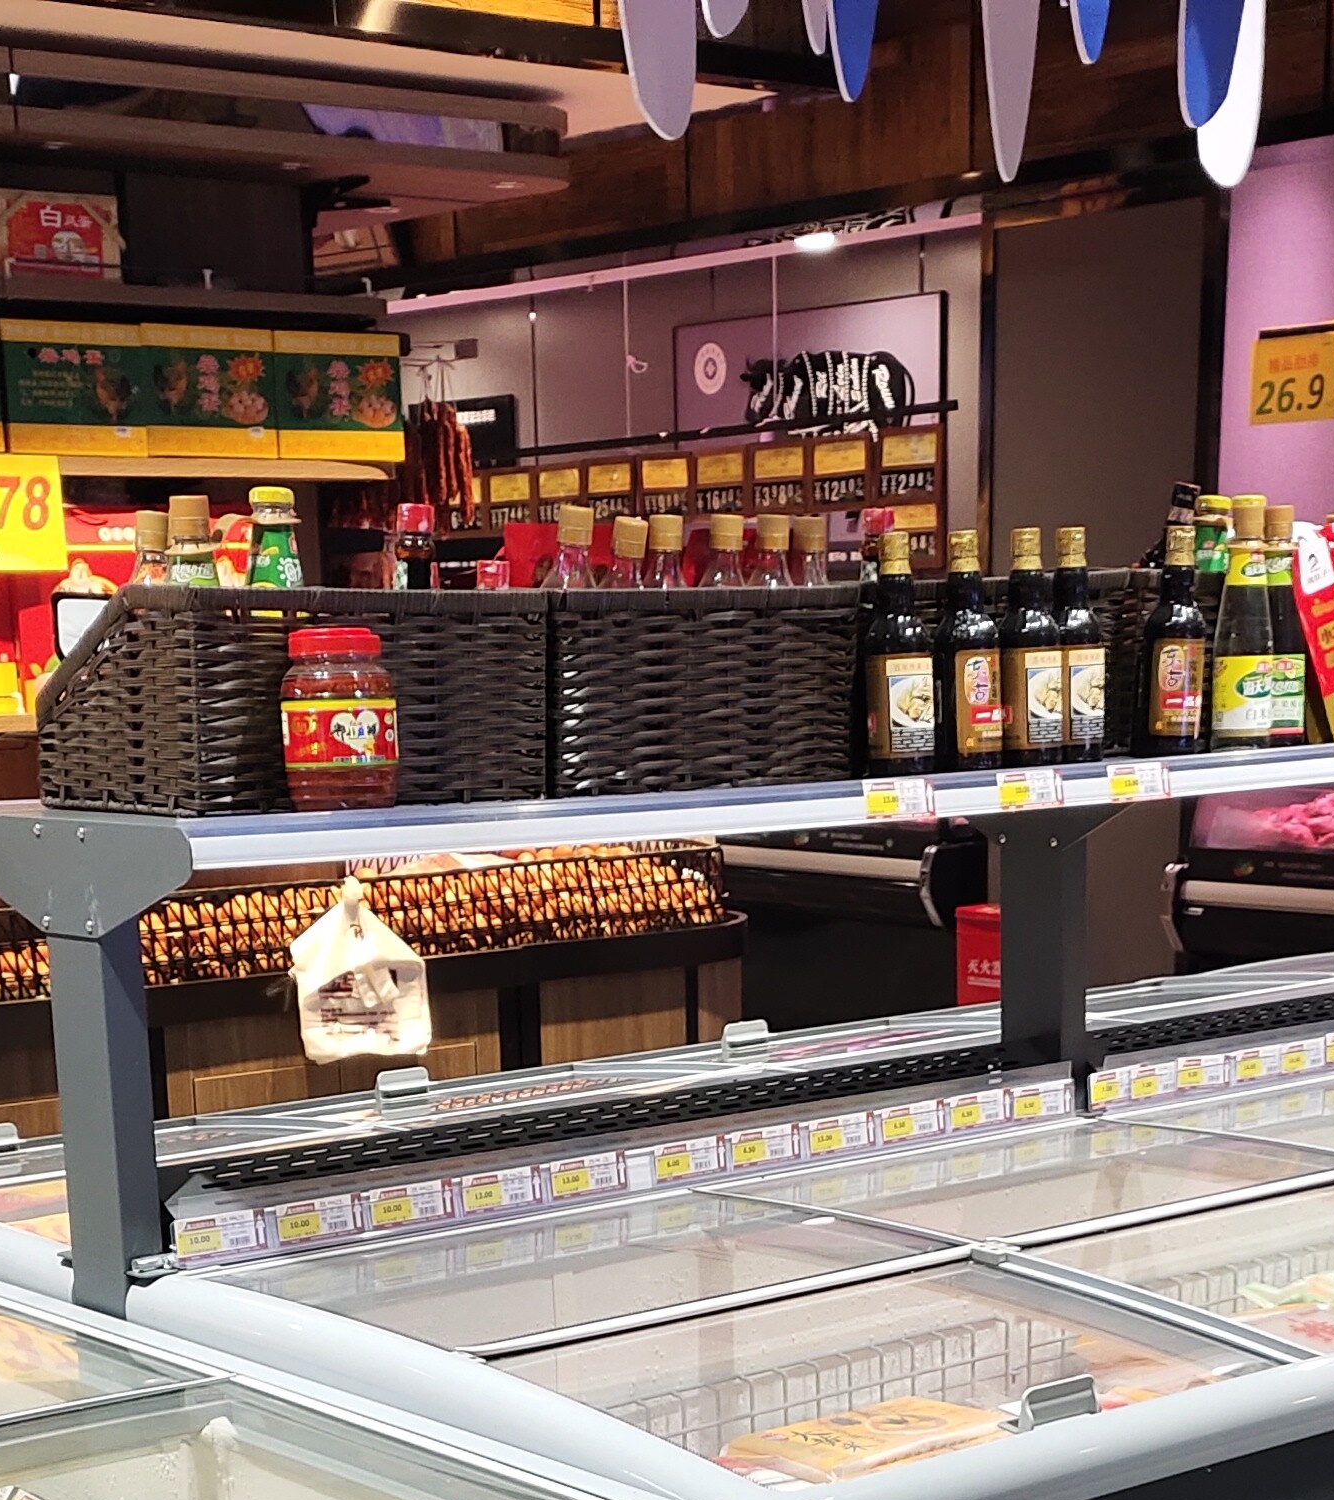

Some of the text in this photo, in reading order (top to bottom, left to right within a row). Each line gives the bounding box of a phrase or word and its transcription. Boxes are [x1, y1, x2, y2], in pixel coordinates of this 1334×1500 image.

[1256, 373, 1325, 415] 26.9
[289, 1218, 310, 1230] 10.00
[189, 1234, 211, 1246] 10.00
